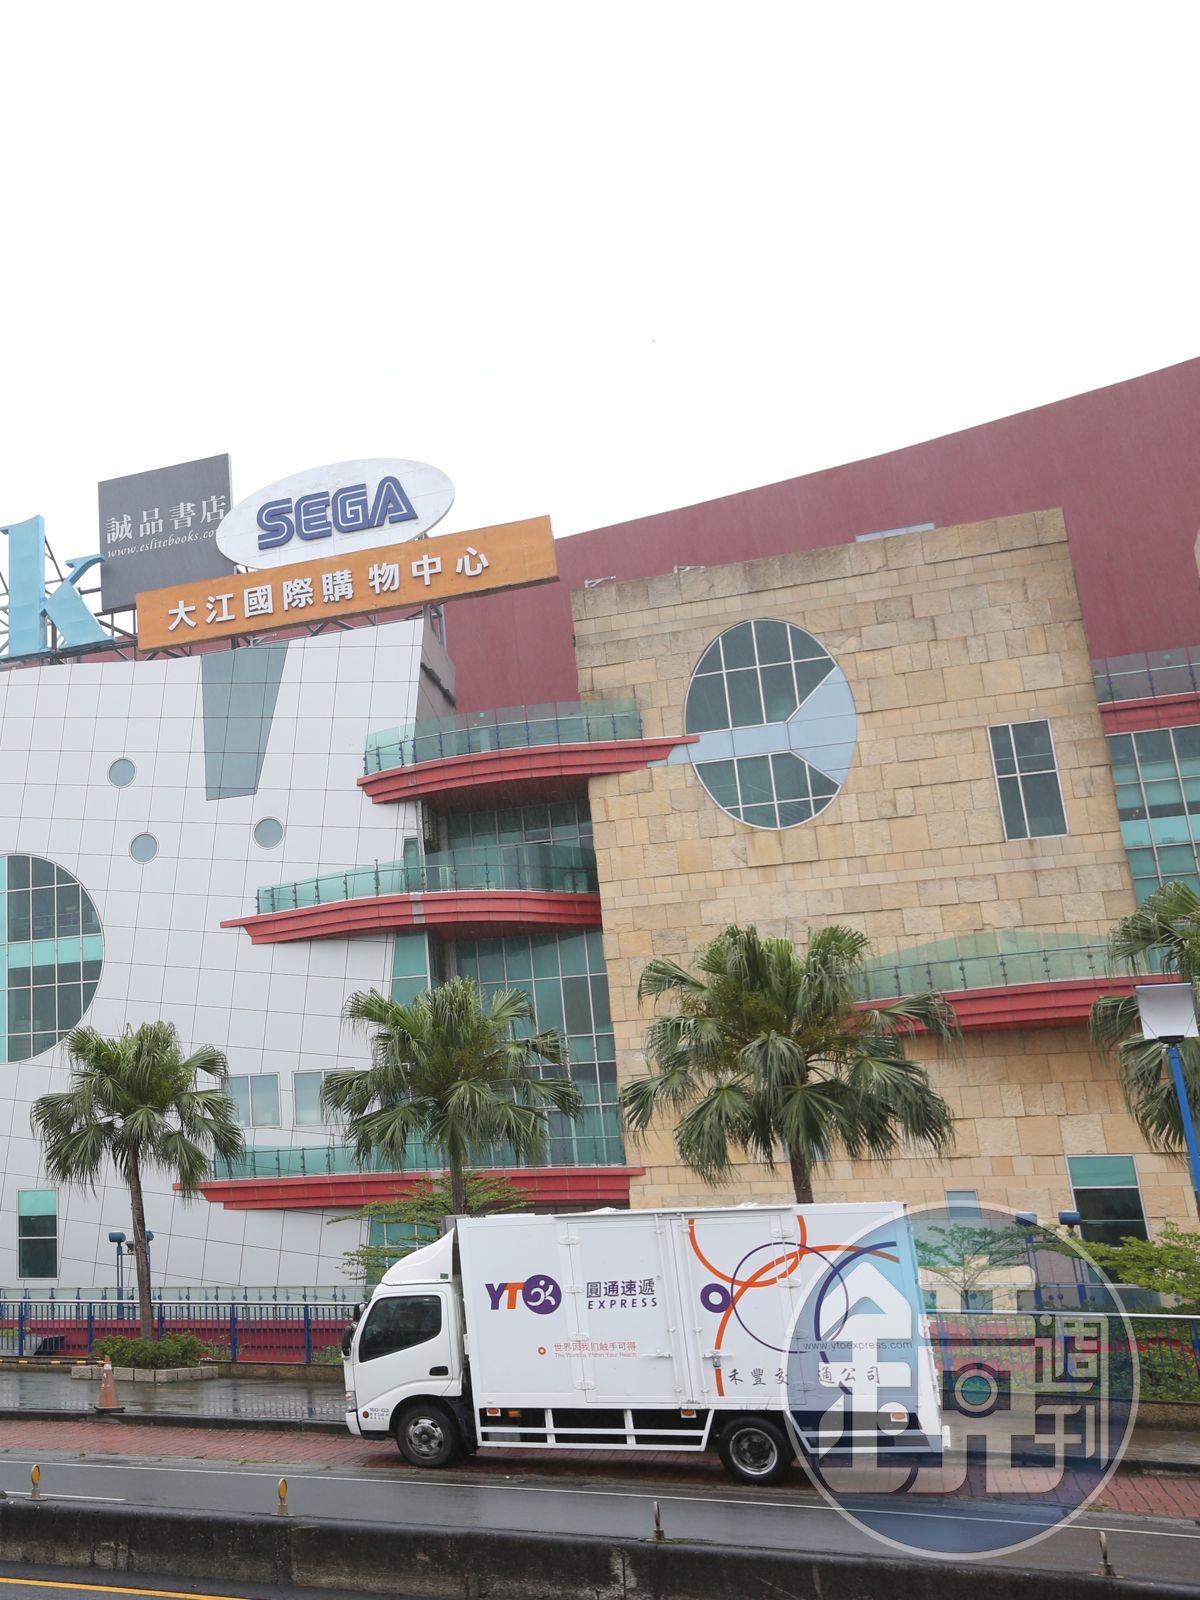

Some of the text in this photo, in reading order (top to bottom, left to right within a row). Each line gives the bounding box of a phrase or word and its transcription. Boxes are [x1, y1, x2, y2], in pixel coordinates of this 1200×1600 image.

[104, 495, 226, 544] 誠品書店
[257, 475, 418, 550] SEGA
[107, 529, 218, 558] www.eslitebooks.co
[167, 546, 490, 632] 大江國際購物中心
[586, 1278, 656, 1299] 圓通速遞
[587, 1297, 658, 1310] EXPRESS
[803, 1340, 913, 1351] www.ytoexpress.com
